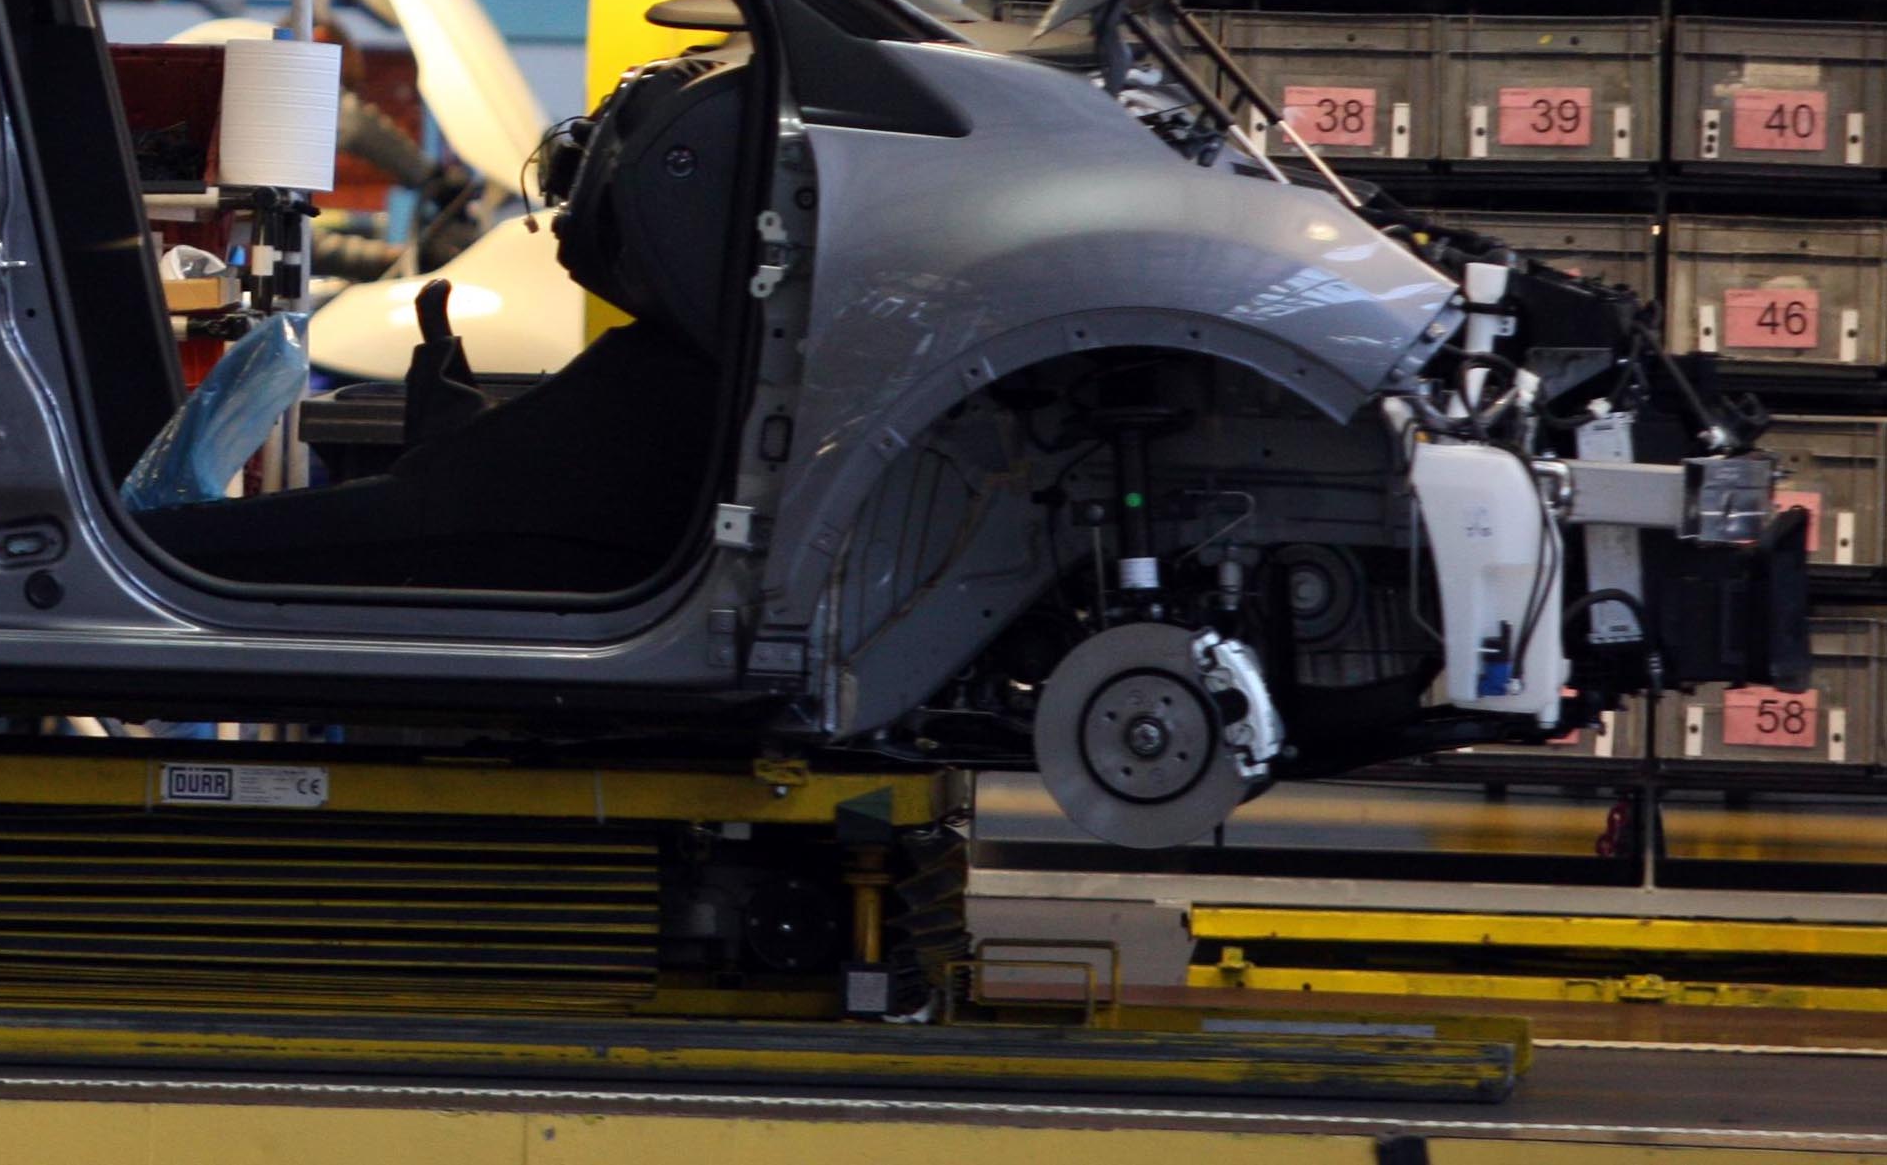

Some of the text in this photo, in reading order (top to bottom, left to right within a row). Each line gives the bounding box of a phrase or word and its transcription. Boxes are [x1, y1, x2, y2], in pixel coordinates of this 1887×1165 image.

[1315, 98, 1364, 133] 38
[1530, 98, 1581, 133] 39
[1763, 103, 1815, 138] 40
[1756, 300, 1807, 335] 46
[1756, 699, 1807, 734] 58
